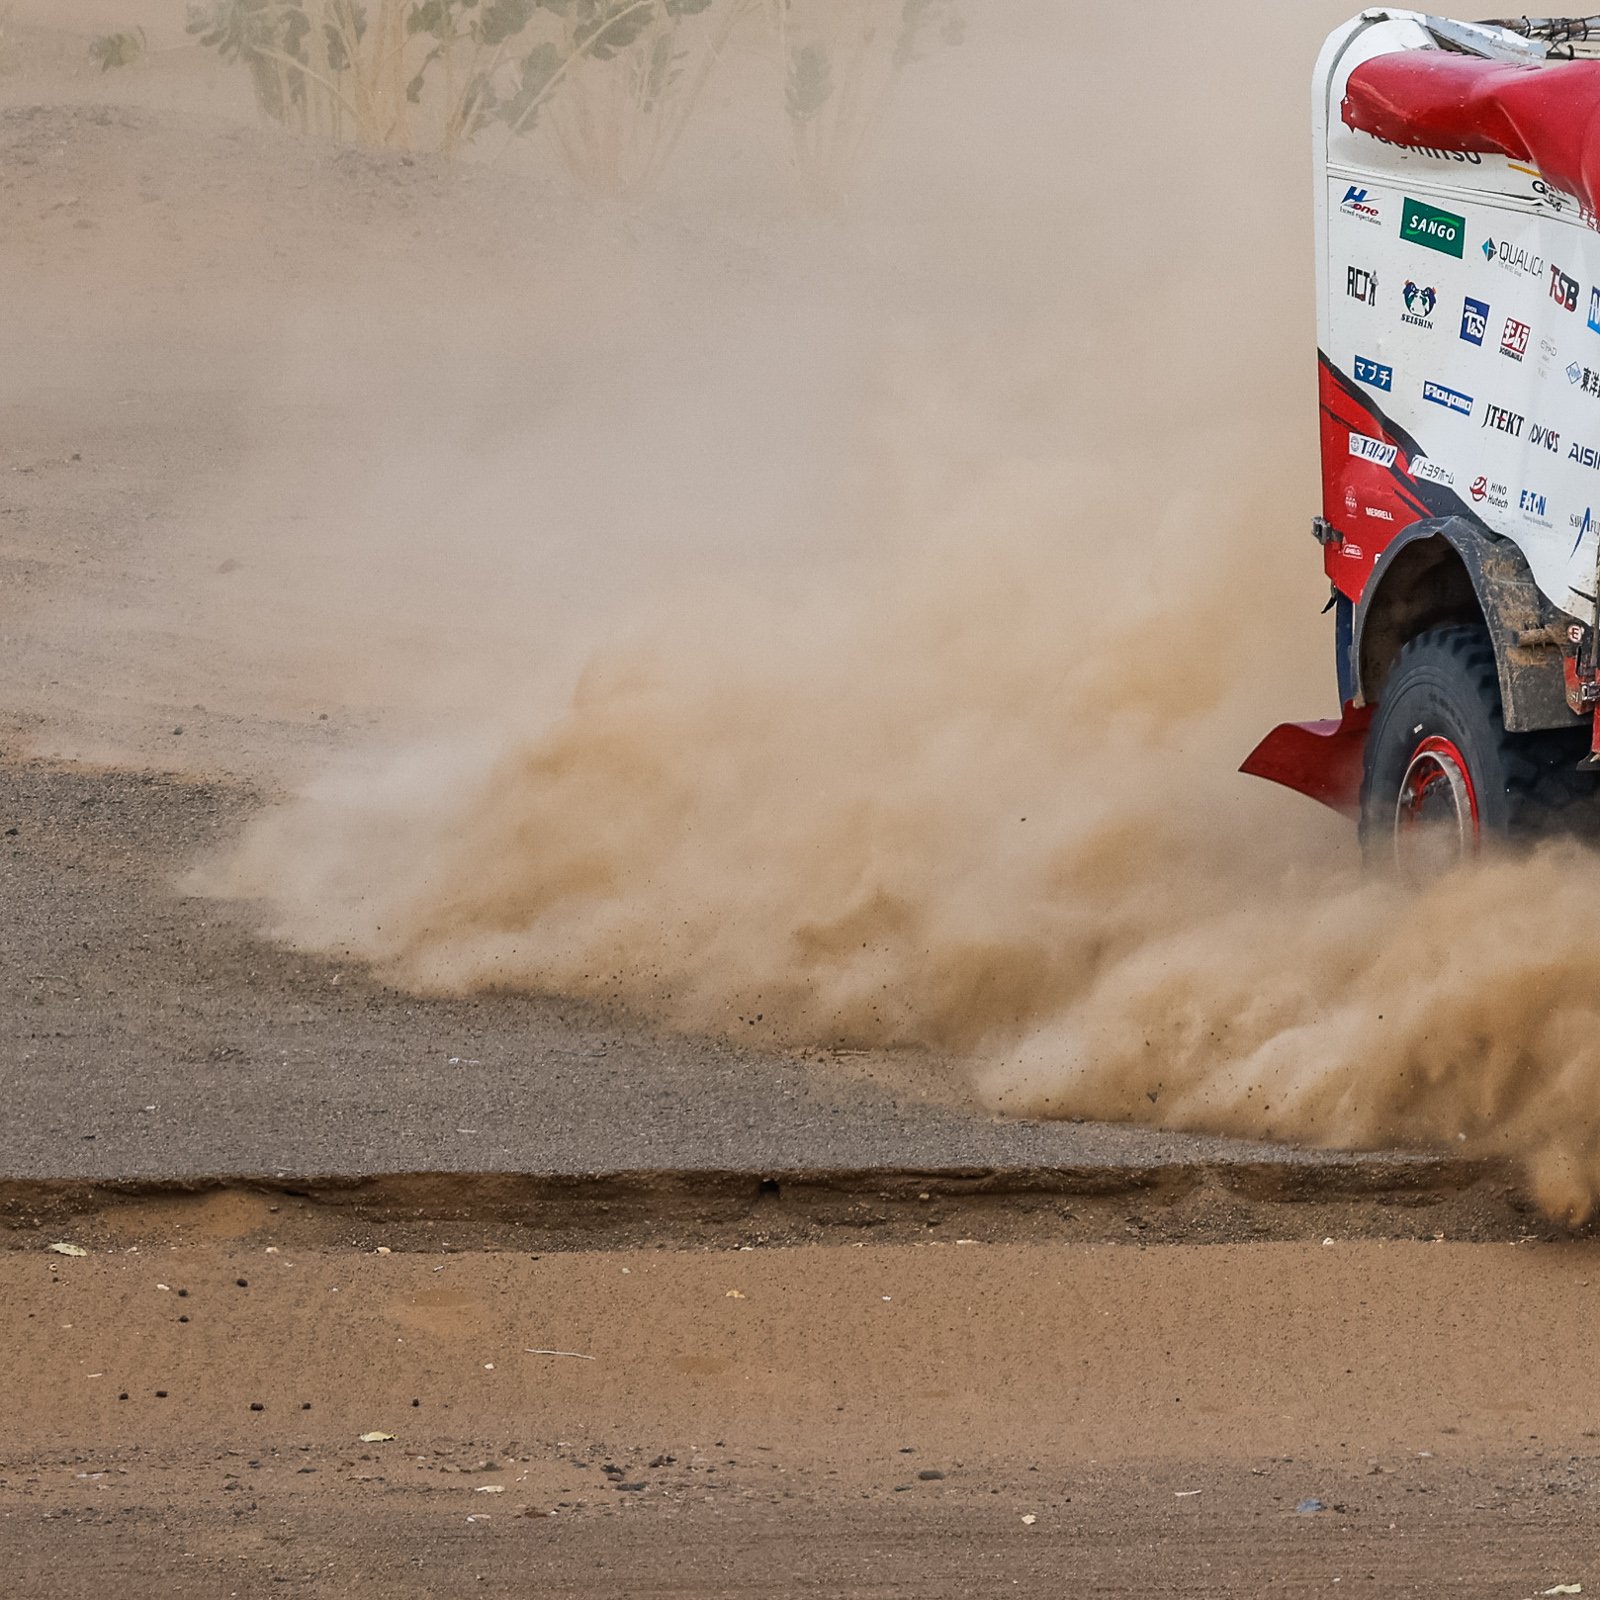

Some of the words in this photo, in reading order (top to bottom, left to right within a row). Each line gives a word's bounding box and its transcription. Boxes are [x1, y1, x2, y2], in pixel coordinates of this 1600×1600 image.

[1410, 215, 1456, 241] SANGO
[1499, 241, 1544, 279] QUALICA
[1549, 264, 1580, 312] TSB
[1401, 314, 1433, 329] SEISHIN
[1464, 311, 1486, 339] T&S
[1481, 403, 1525, 438] JTEKT
[1487, 494, 1509, 509] Hutech
[1490, 483, 1507, 496] HINO
[1572, 628, 1579, 640] E
